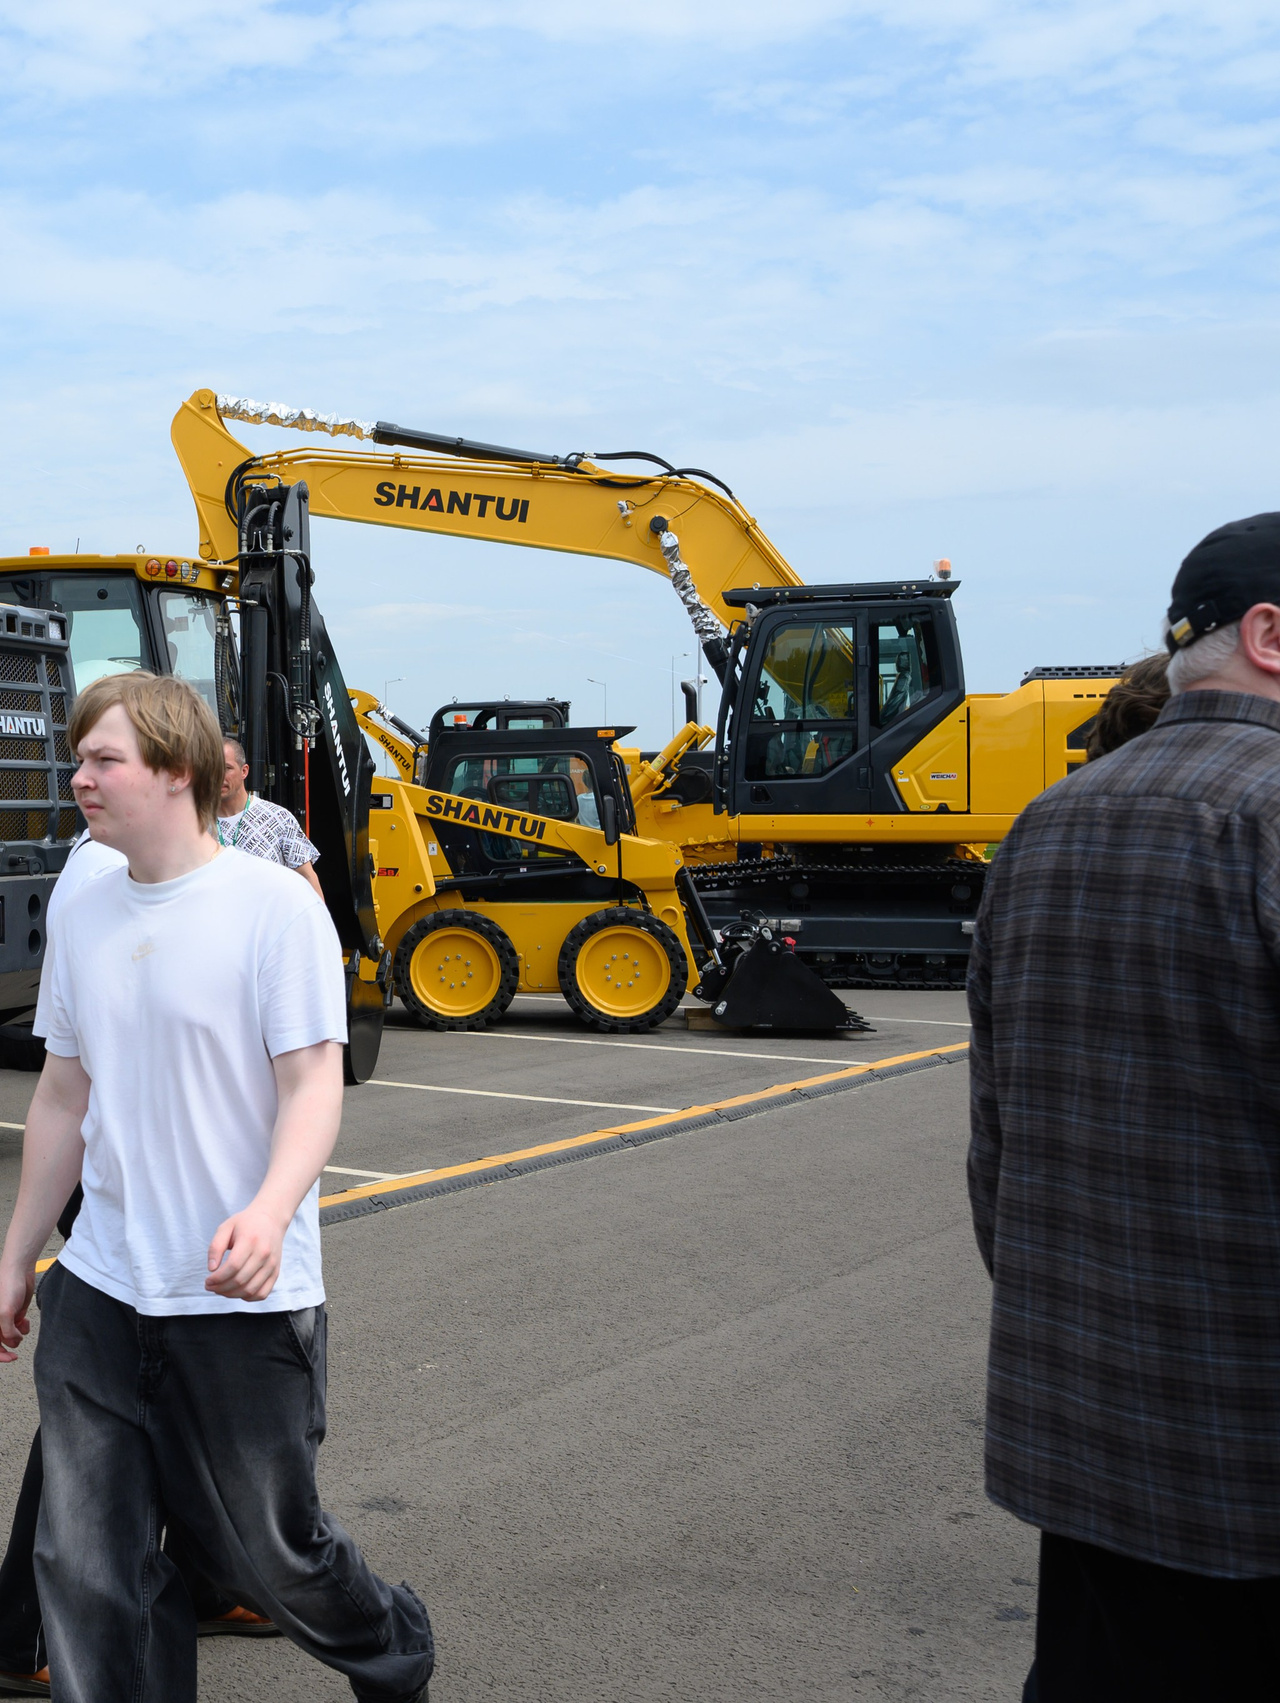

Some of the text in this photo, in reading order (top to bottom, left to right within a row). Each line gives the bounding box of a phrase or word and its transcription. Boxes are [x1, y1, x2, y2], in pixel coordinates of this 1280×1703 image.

[373, 481, 530, 523] SHANTUI
[324, 682, 351, 797] SHANTUI
[378, 734, 412, 771] SHANTUI
[425, 795, 546, 840] SHANTUI
